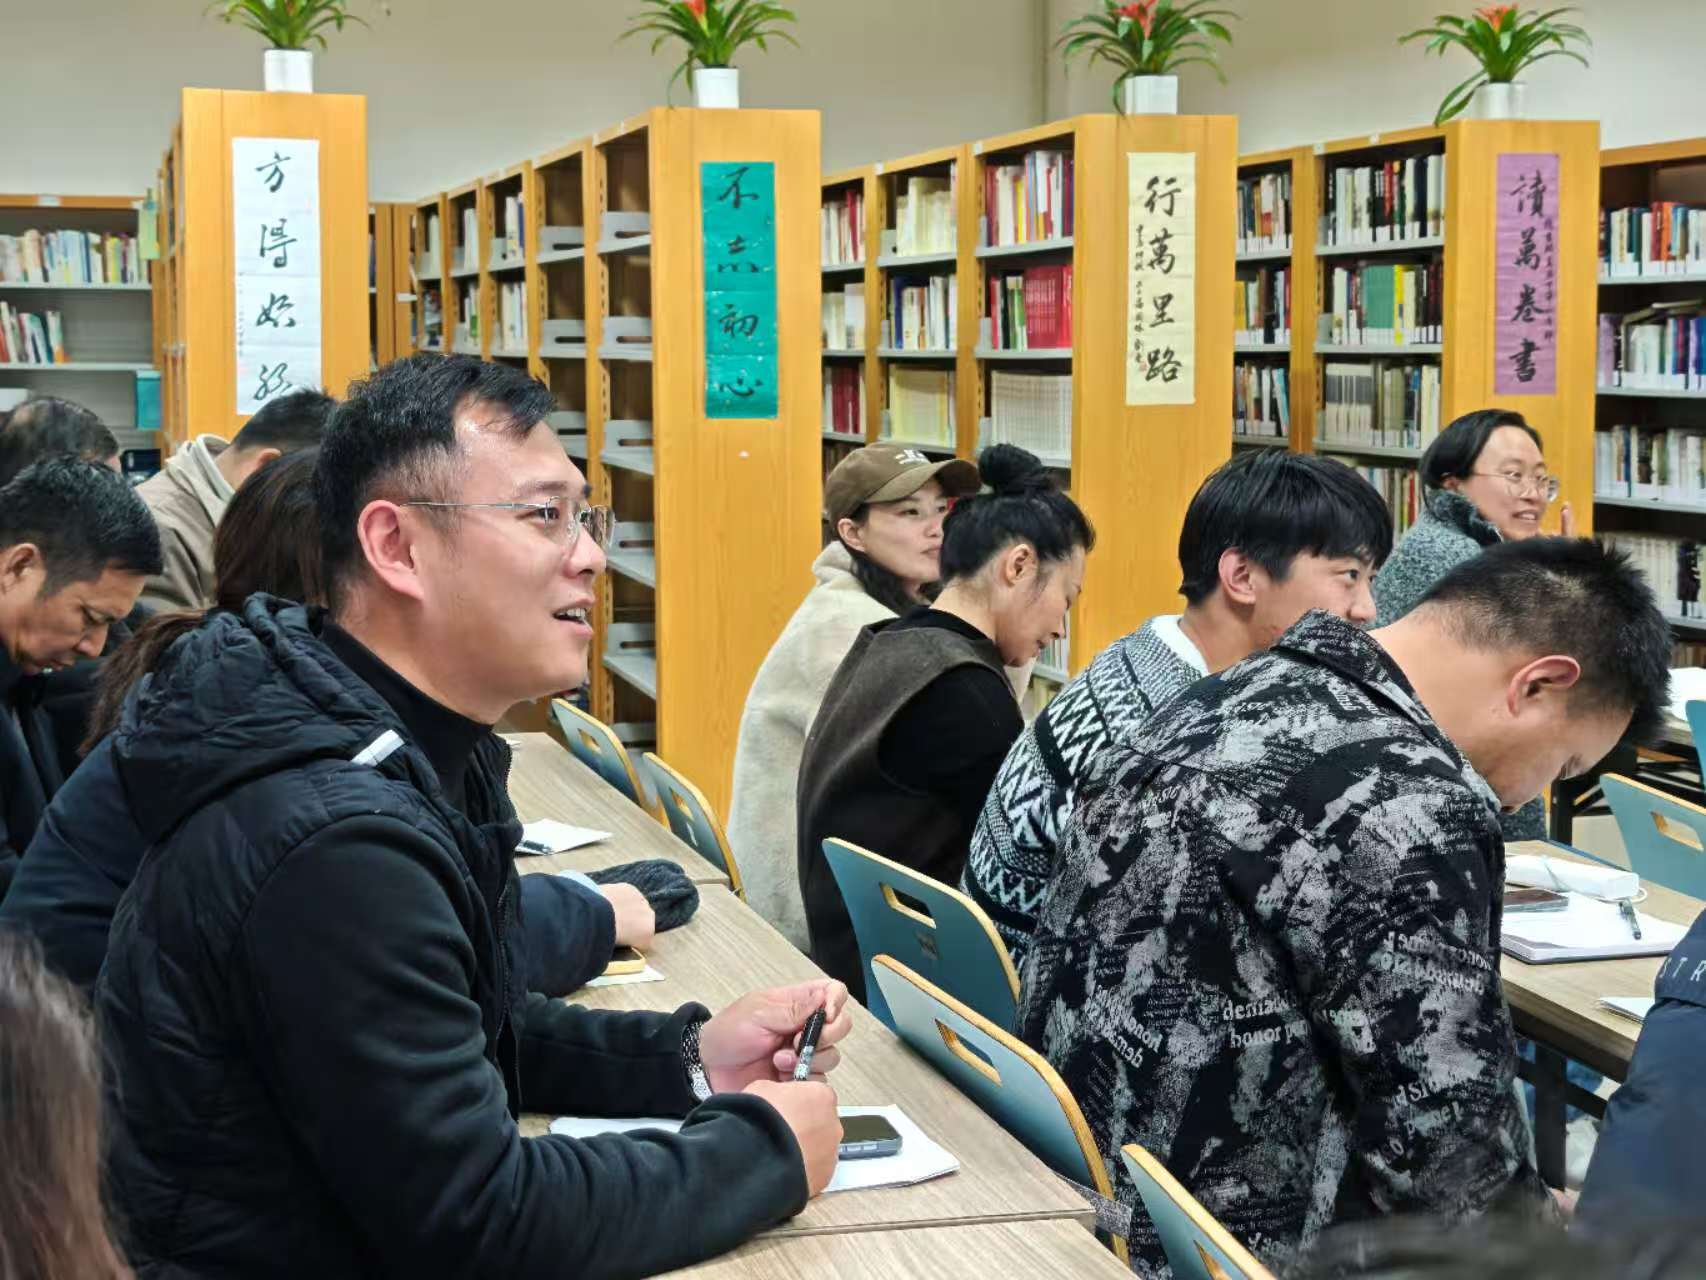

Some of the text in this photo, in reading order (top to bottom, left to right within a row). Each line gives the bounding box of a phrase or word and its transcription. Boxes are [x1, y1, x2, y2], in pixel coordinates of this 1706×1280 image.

[717, 166, 762, 398] 不忘初心
[1144, 176, 1182, 383] 行萬里路
